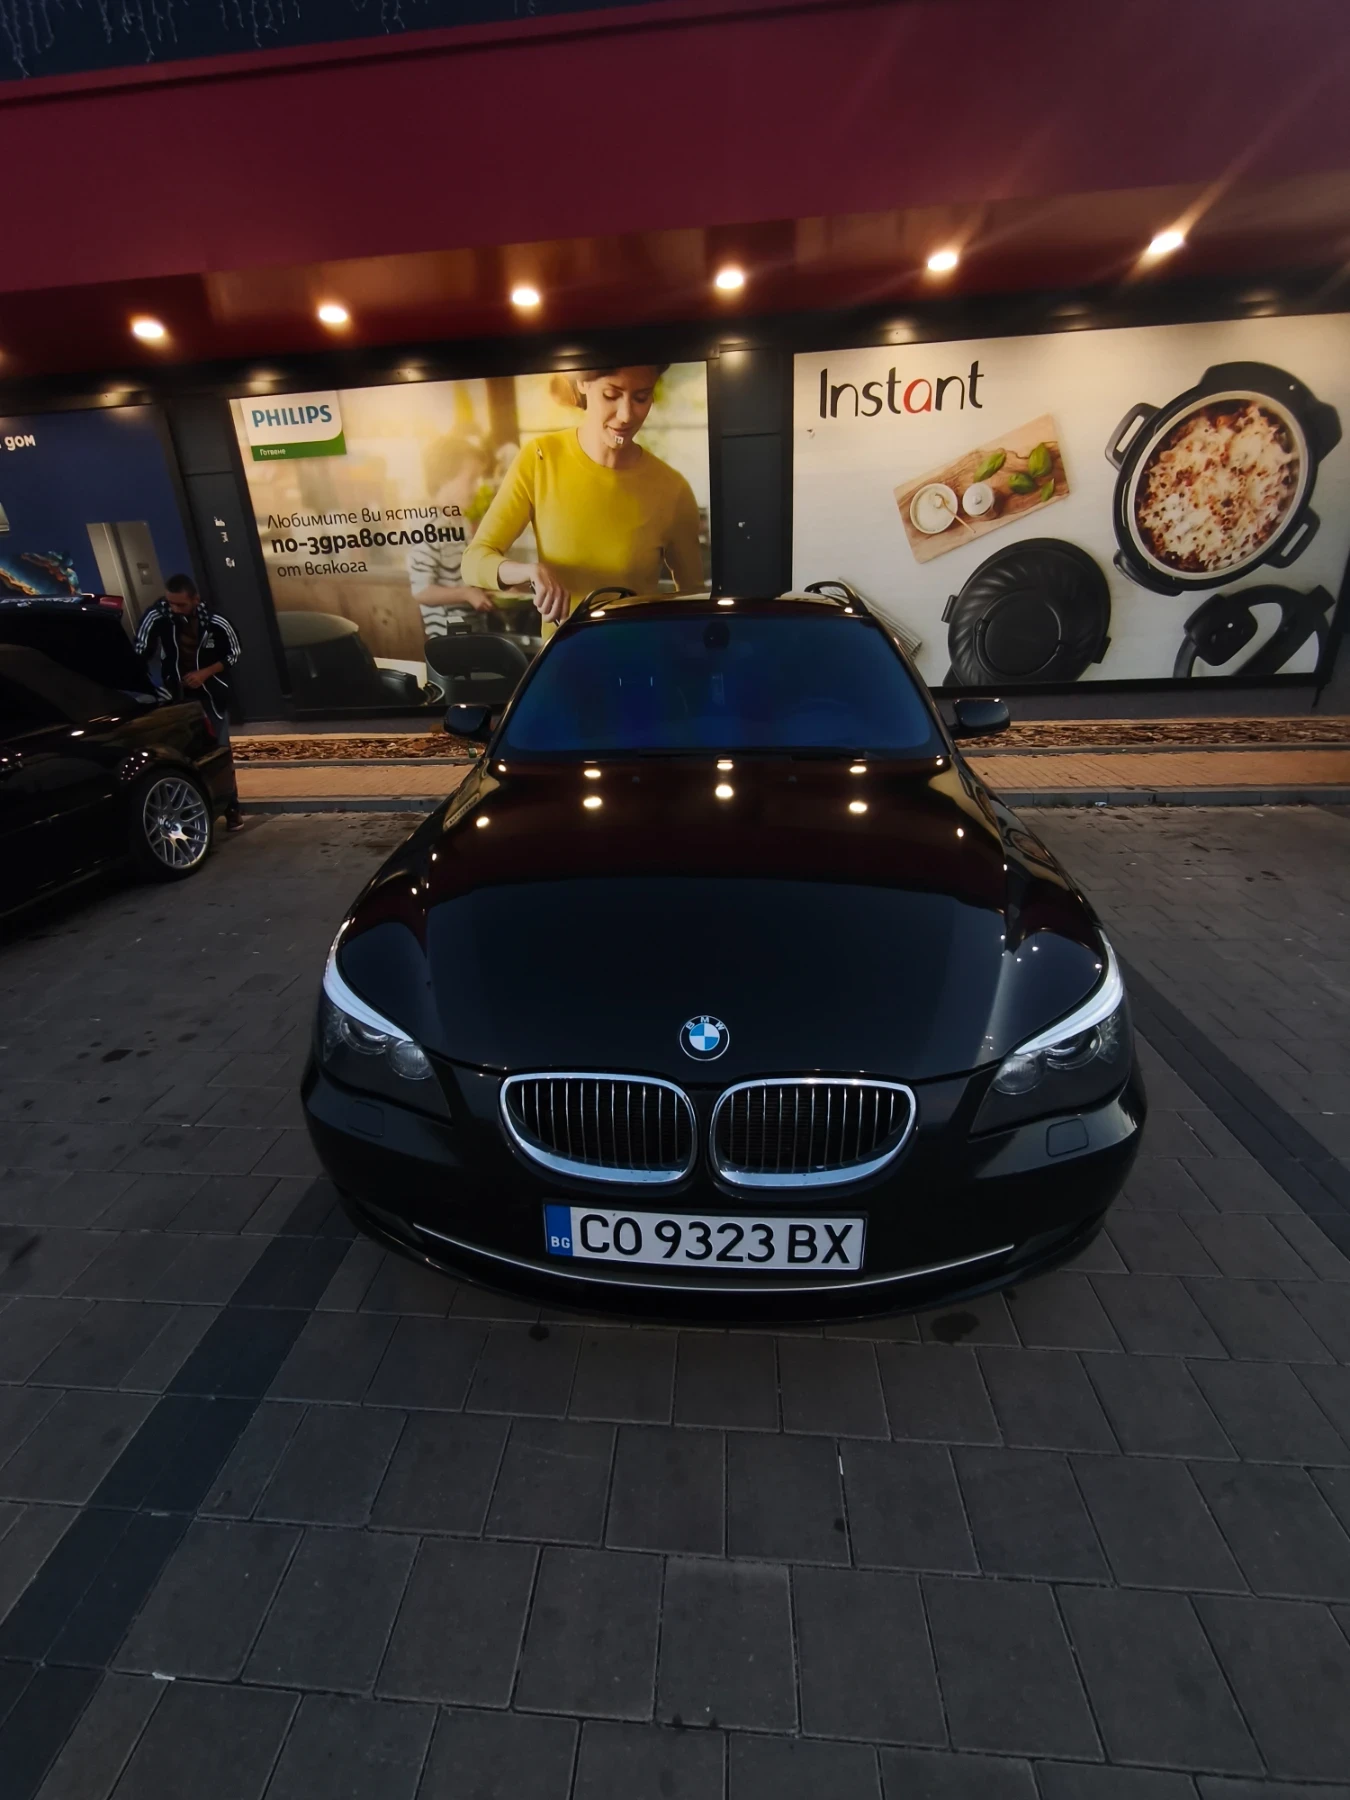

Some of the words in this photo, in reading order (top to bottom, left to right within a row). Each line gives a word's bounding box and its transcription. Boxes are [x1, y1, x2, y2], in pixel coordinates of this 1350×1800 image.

[820, 360, 984, 419] Instant
[251, 404, 332, 428] PHILIPS
[267, 512, 358, 530] Любимите
[361, 507, 382, 523] ви
[385, 505, 438, 521] ястия
[442, 505, 462, 517] са
[271, 523, 466, 556] по-здравословни
[277, 564, 302, 578] от
[304, 560, 368, 576] всякога
[685, 1016, 726, 1031] BMW
[551, 1236, 571, 1249] BG
[654, 1219, 775, 1263] 9323
[787, 1223, 853, 1264] BX
